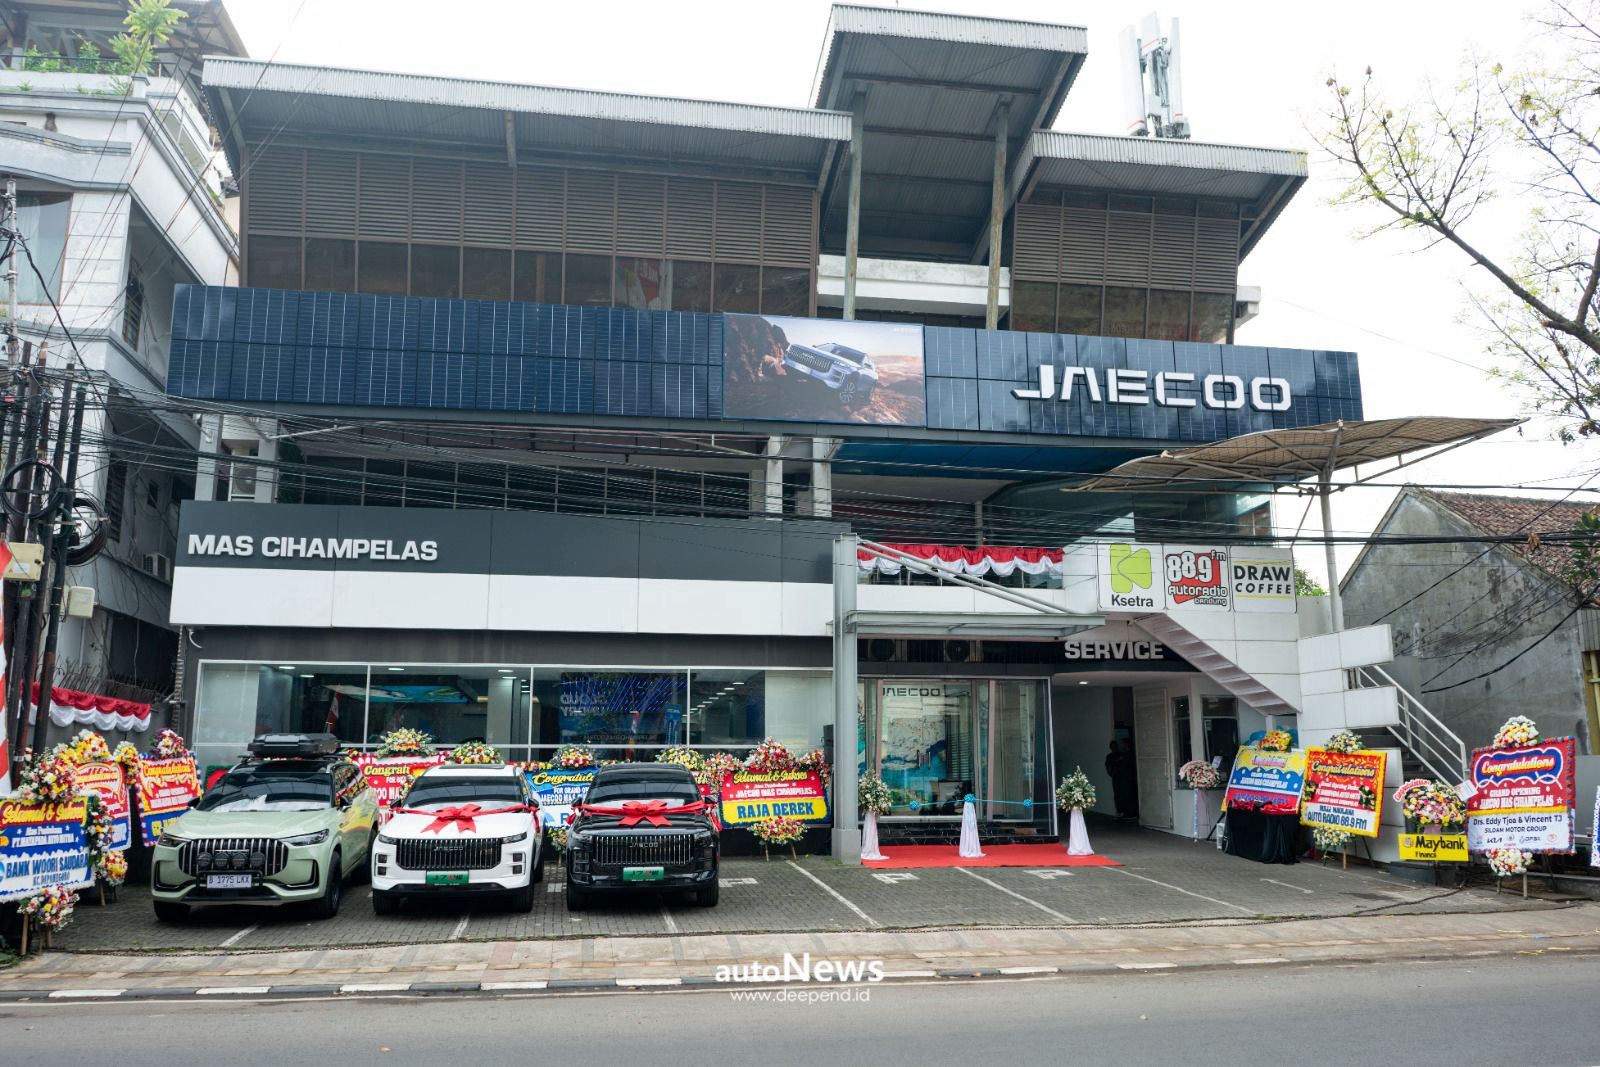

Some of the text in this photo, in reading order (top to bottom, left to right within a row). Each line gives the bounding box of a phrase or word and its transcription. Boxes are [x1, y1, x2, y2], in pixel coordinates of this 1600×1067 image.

[1010, 364, 1292, 411] JAECOO
[187, 534, 439, 561] MAS CIHAMPELAS
[1166, 551, 1214, 583] 88.9
[1234, 565, 1291, 582] DRAW
[1235, 582, 1292, 595] COFFEE
[1111, 594, 1154, 608] Ksetra
[1064, 640, 1164, 660] SERVICE
[1312, 760, 1375, 778] Congratulations
[1482, 756, 1555, 776] Congratulations
[733, 771, 771, 784] Selamat
[761, 788, 775, 797] MAS
[737, 802, 815, 818] RAJA DEREK
[1307, 811, 1322, 823] AUTO
[1322, 812, 1340, 825] RADIO
[1486, 816, 1502, 825] Eddy
[1503, 816, 1518, 825] Tjoa
[1525, 815, 1552, 823] Vincent
[1415, 836, 1465, 852] Maybank
[6, 860, 31, 879] BANK
[32, 857, 59, 875] WOORI
